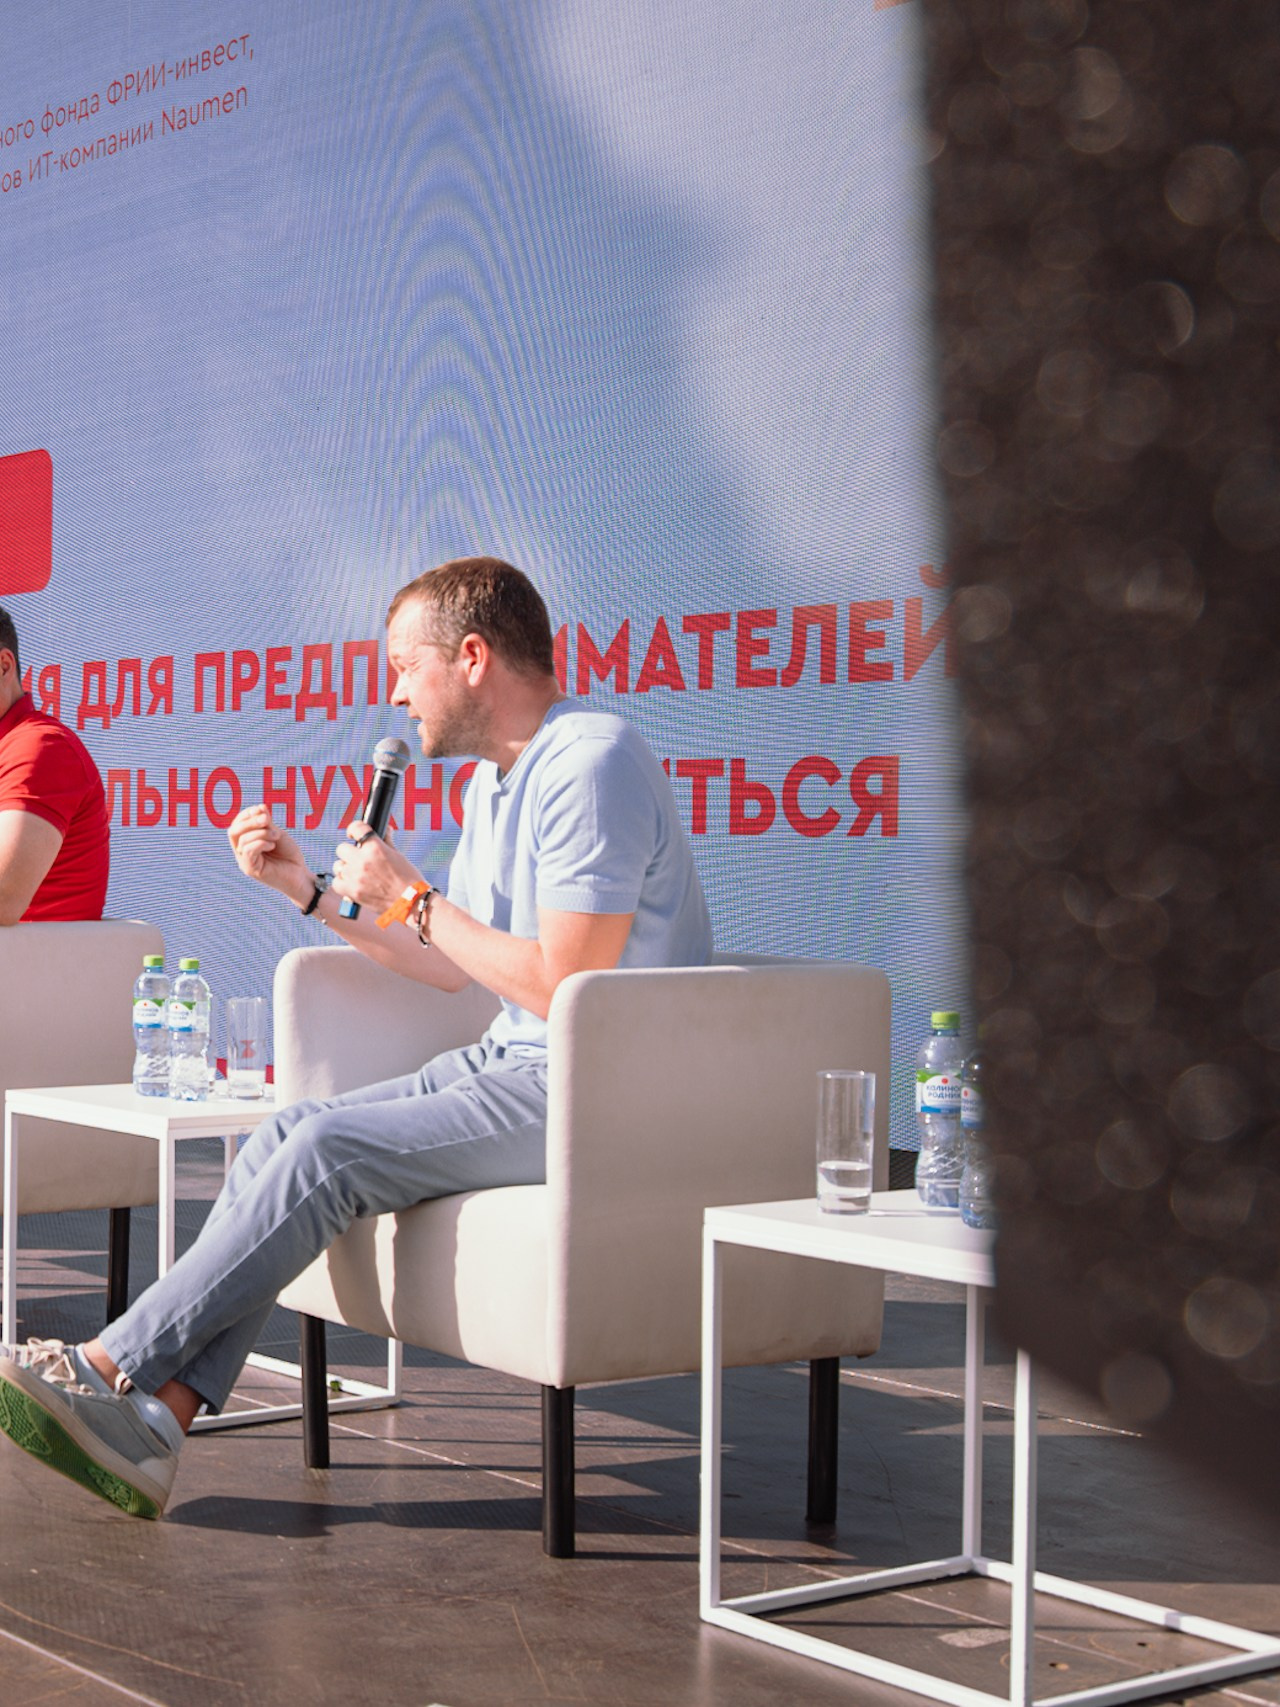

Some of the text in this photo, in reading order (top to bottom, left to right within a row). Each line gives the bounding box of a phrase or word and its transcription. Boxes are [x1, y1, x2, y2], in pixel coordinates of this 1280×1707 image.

[41, 93, 100, 137] фонда
[107, 34, 253, 105] ФРИИ-инвест,
[29, 120, 153, 182] ИТ-компании
[162, 86, 248, 135] Naumen
[77, 656, 173, 730] ДЛЯ
